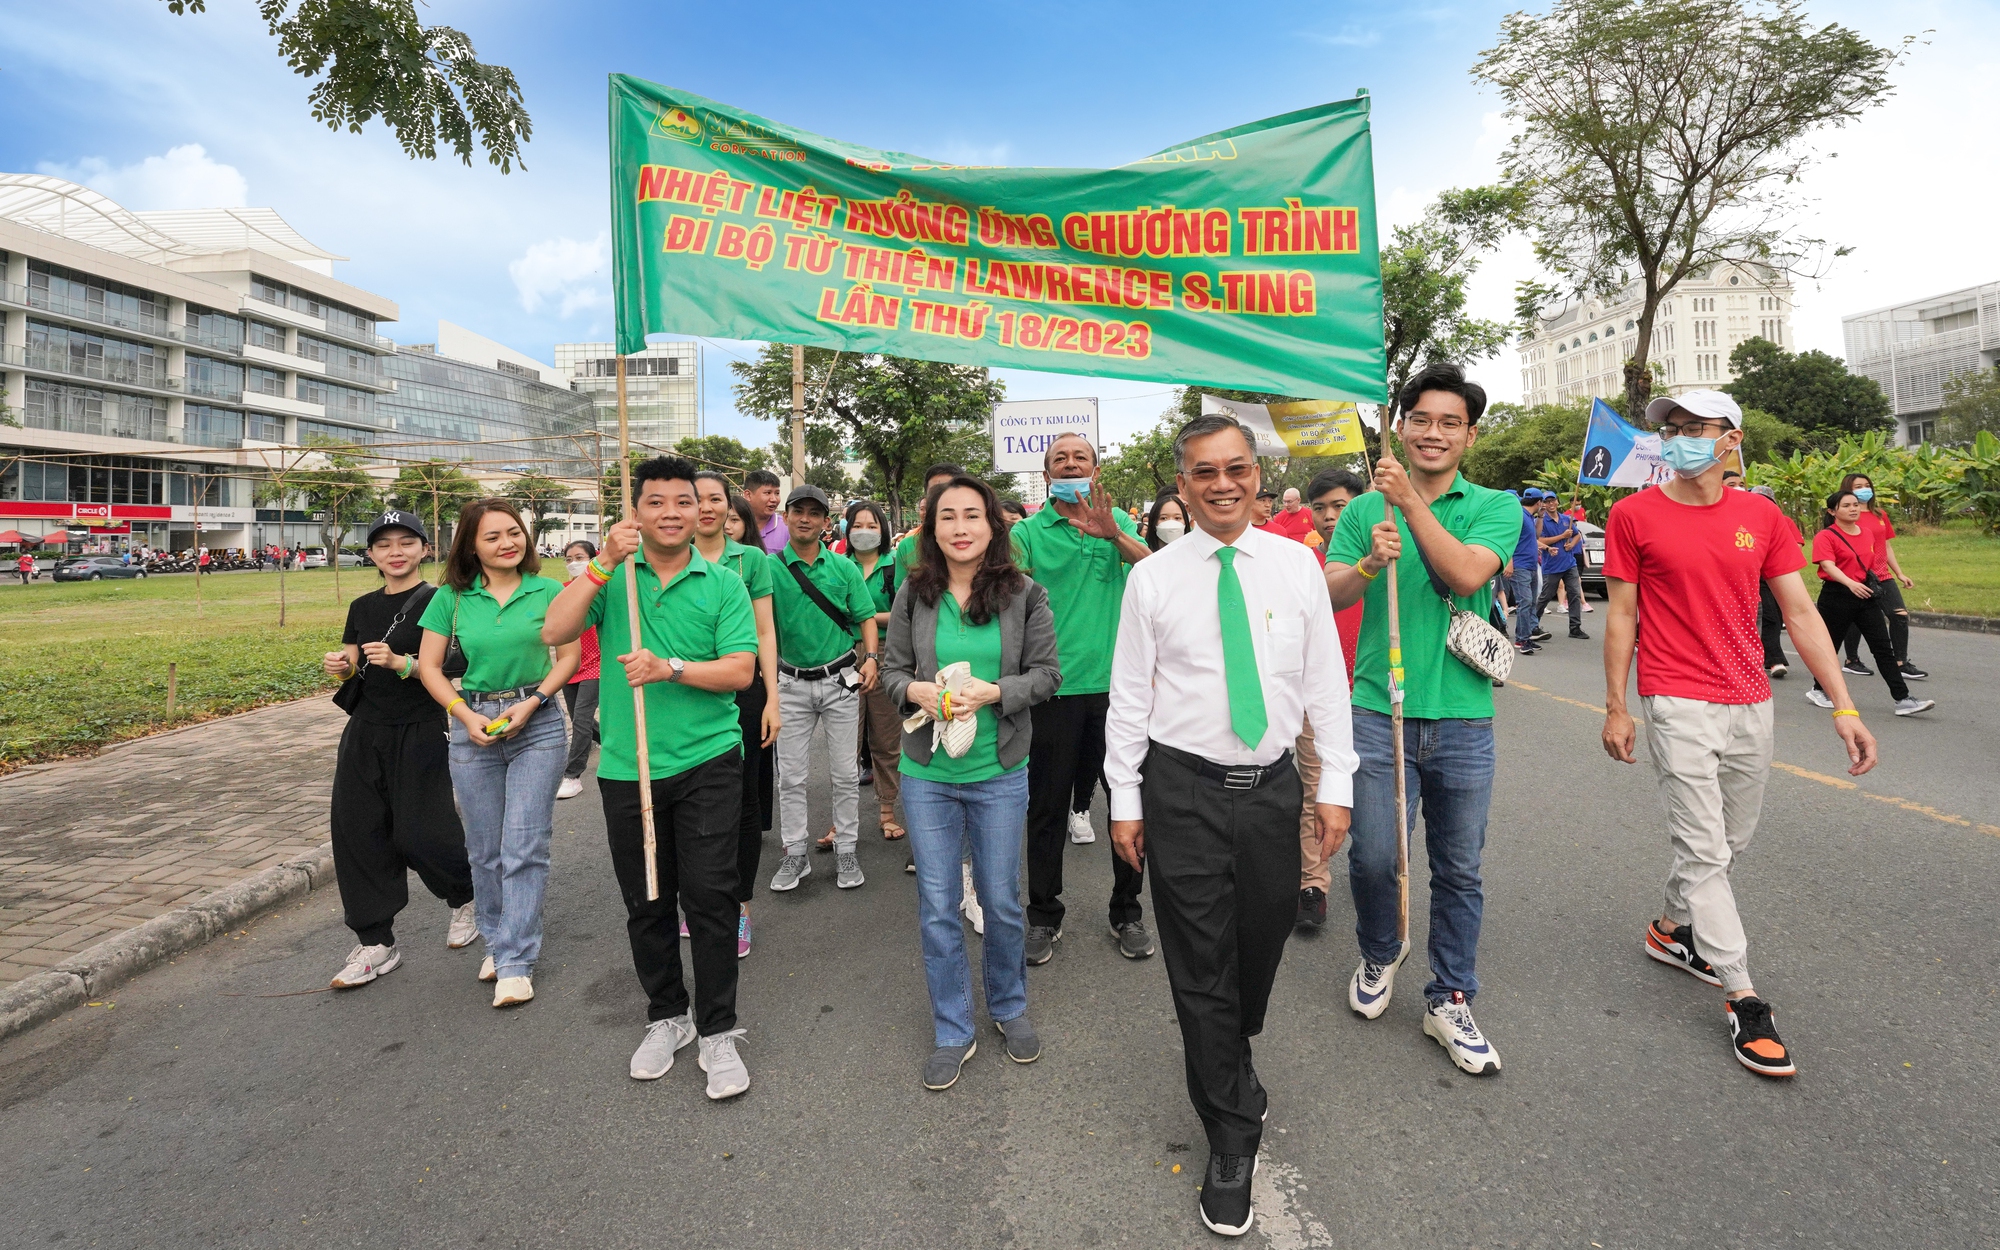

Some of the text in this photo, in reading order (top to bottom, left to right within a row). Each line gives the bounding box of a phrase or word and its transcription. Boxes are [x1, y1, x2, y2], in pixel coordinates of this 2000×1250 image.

[637, 164, 1360, 258] NHIỆT LIỆT HƯỞNG ỨNG CHƯƠNG TRÌNH
[662, 213, 1317, 317] ĐI BỘ TỪ THIỆN LAWRENCE S.TING
[816, 281, 1152, 361] LẦN THỨ 18/2023
[1000, 414, 1090, 427] CÔNG TY KIM LOẠI
[1003, 432, 1087, 454] TACH
[77, 507, 98, 515] CIRCLE
[384, 511, 400, 524] NY
[1735, 531, 1754, 549] 30
[1481, 638, 1499, 663] NY
